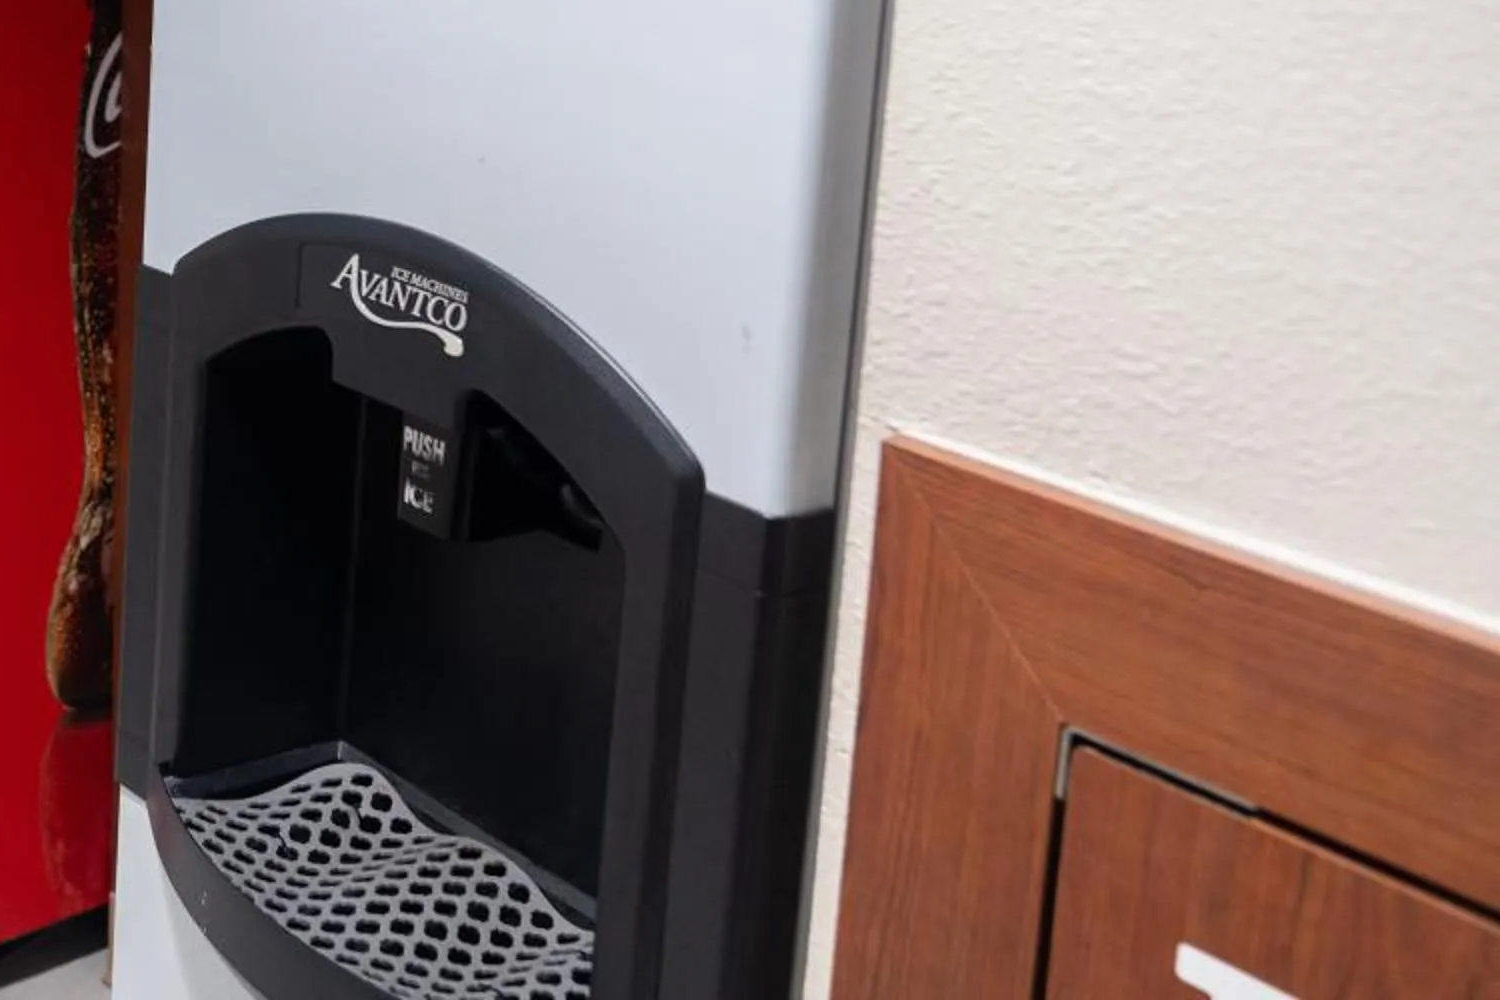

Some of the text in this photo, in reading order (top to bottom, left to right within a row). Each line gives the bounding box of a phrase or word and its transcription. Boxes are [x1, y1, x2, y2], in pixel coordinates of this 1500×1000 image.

[330, 253, 468, 357] AVANTCO
[403, 425, 446, 466] PUSH
[403, 477, 436, 514] ICE
